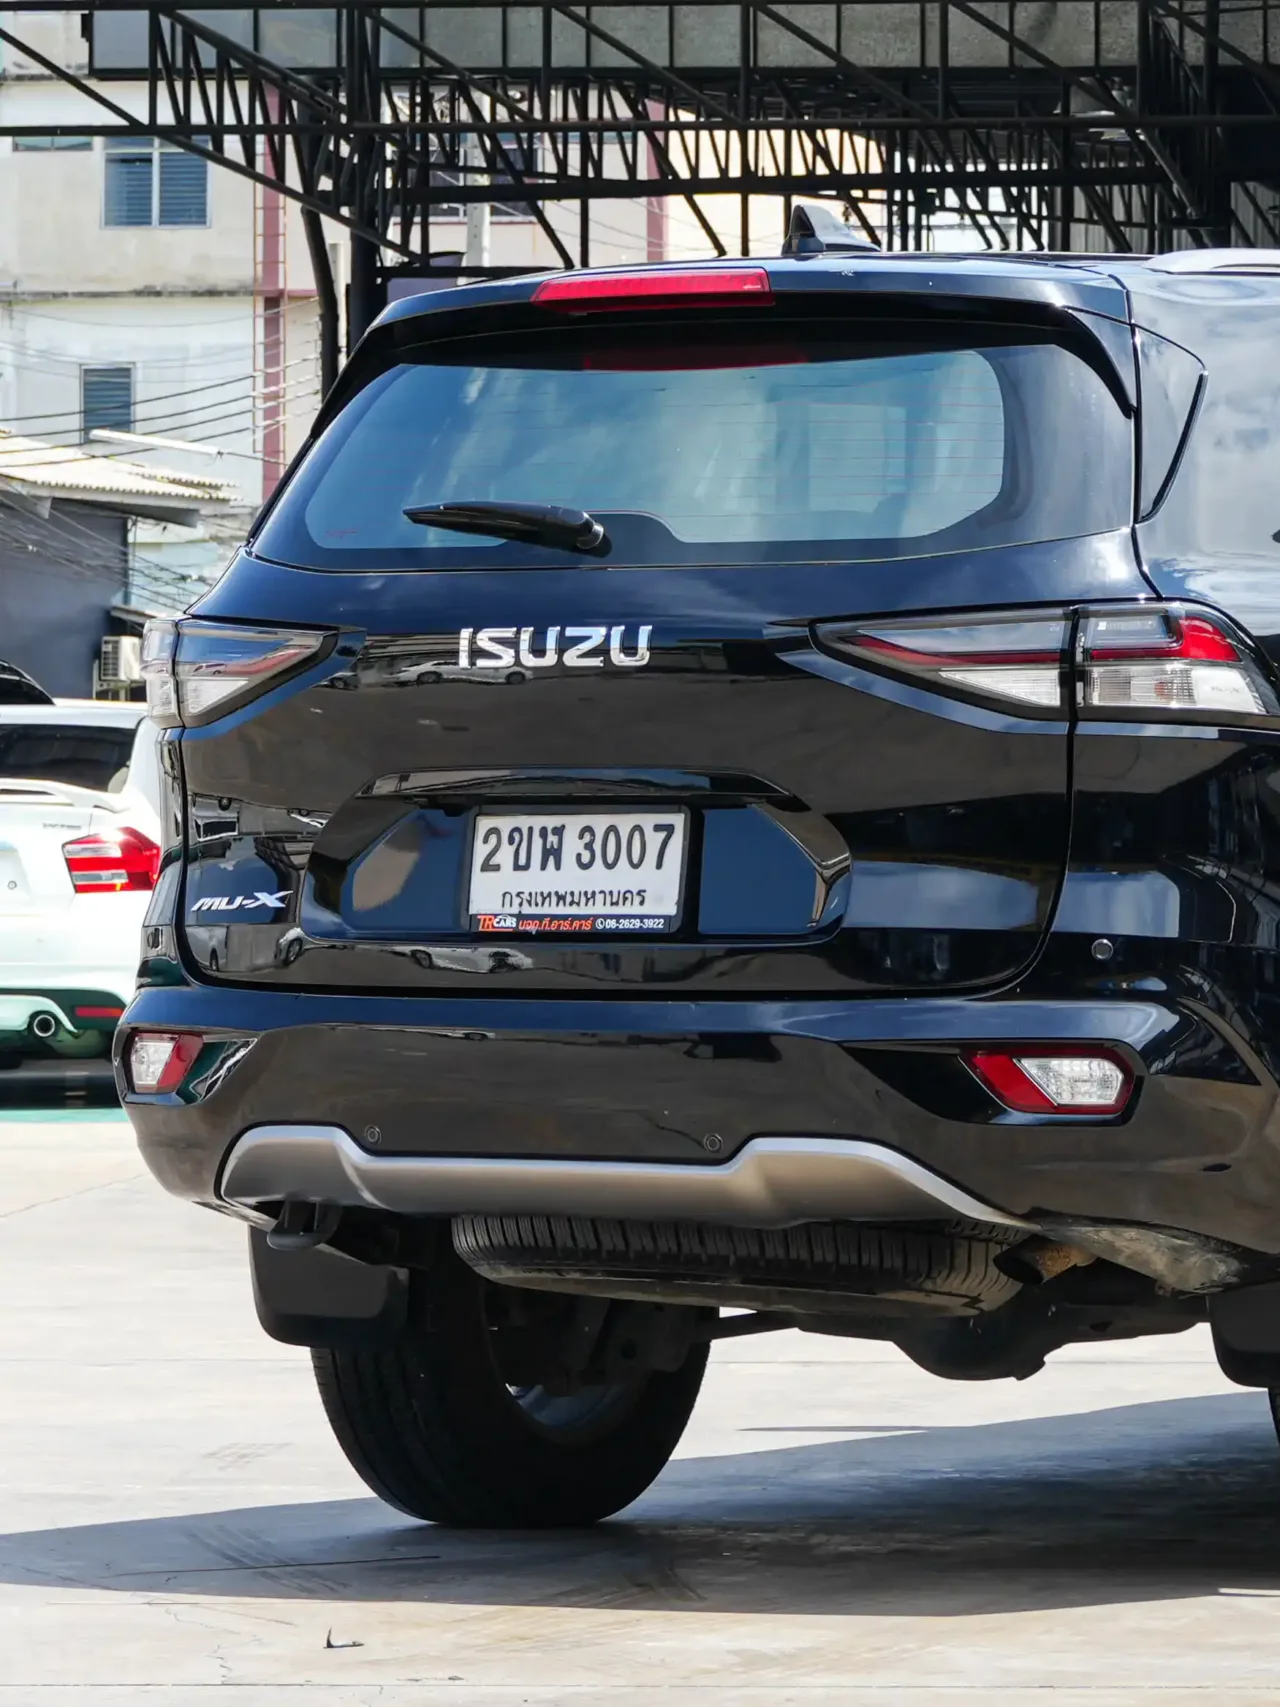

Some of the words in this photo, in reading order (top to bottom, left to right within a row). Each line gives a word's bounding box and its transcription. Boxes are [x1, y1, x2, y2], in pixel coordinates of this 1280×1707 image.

[458, 624, 653, 669] ISUZU
[575, 823, 676, 871] 3007
[501, 888, 648, 914] กรุงเทพมหานคร
